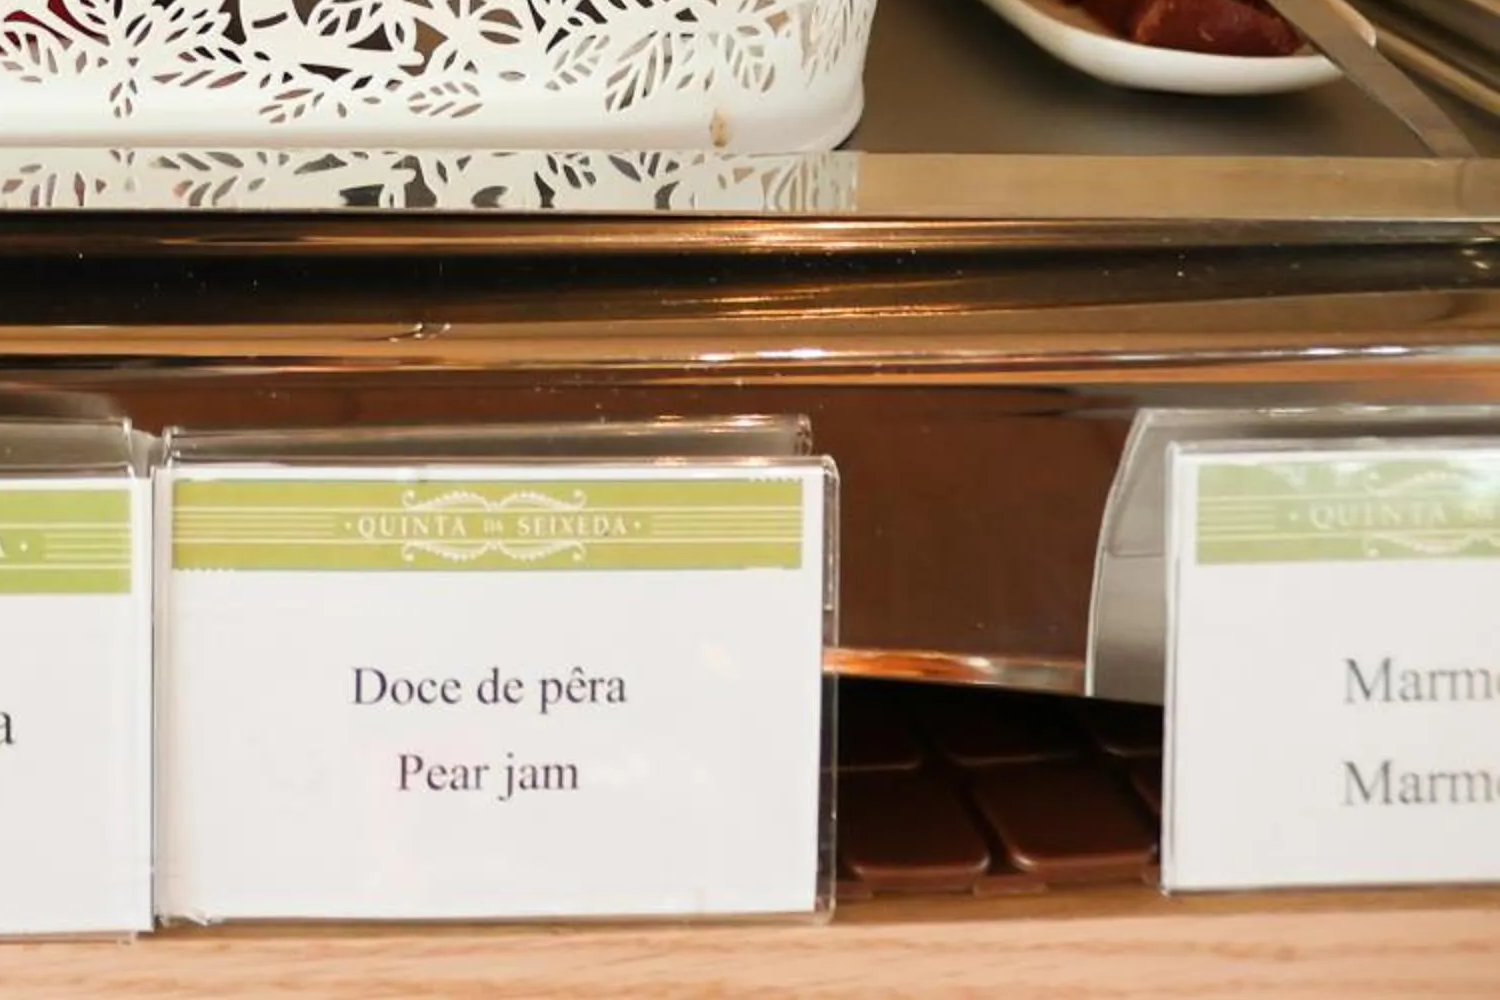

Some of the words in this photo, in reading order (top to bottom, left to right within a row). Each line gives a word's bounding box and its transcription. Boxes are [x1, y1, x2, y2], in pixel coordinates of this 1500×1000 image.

[357, 516, 467, 539] QUINTA
[517, 516, 628, 537] SEIXEDA
[352, 666, 462, 707] Doce
[476, 666, 525, 706] de
[538, 666, 628, 715] pêra
[1344, 657, 1500, 703] Marm
[397, 753, 491, 793] Pear
[496, 752, 580, 802] jam
[1343, 760, 1500, 806] Marm
